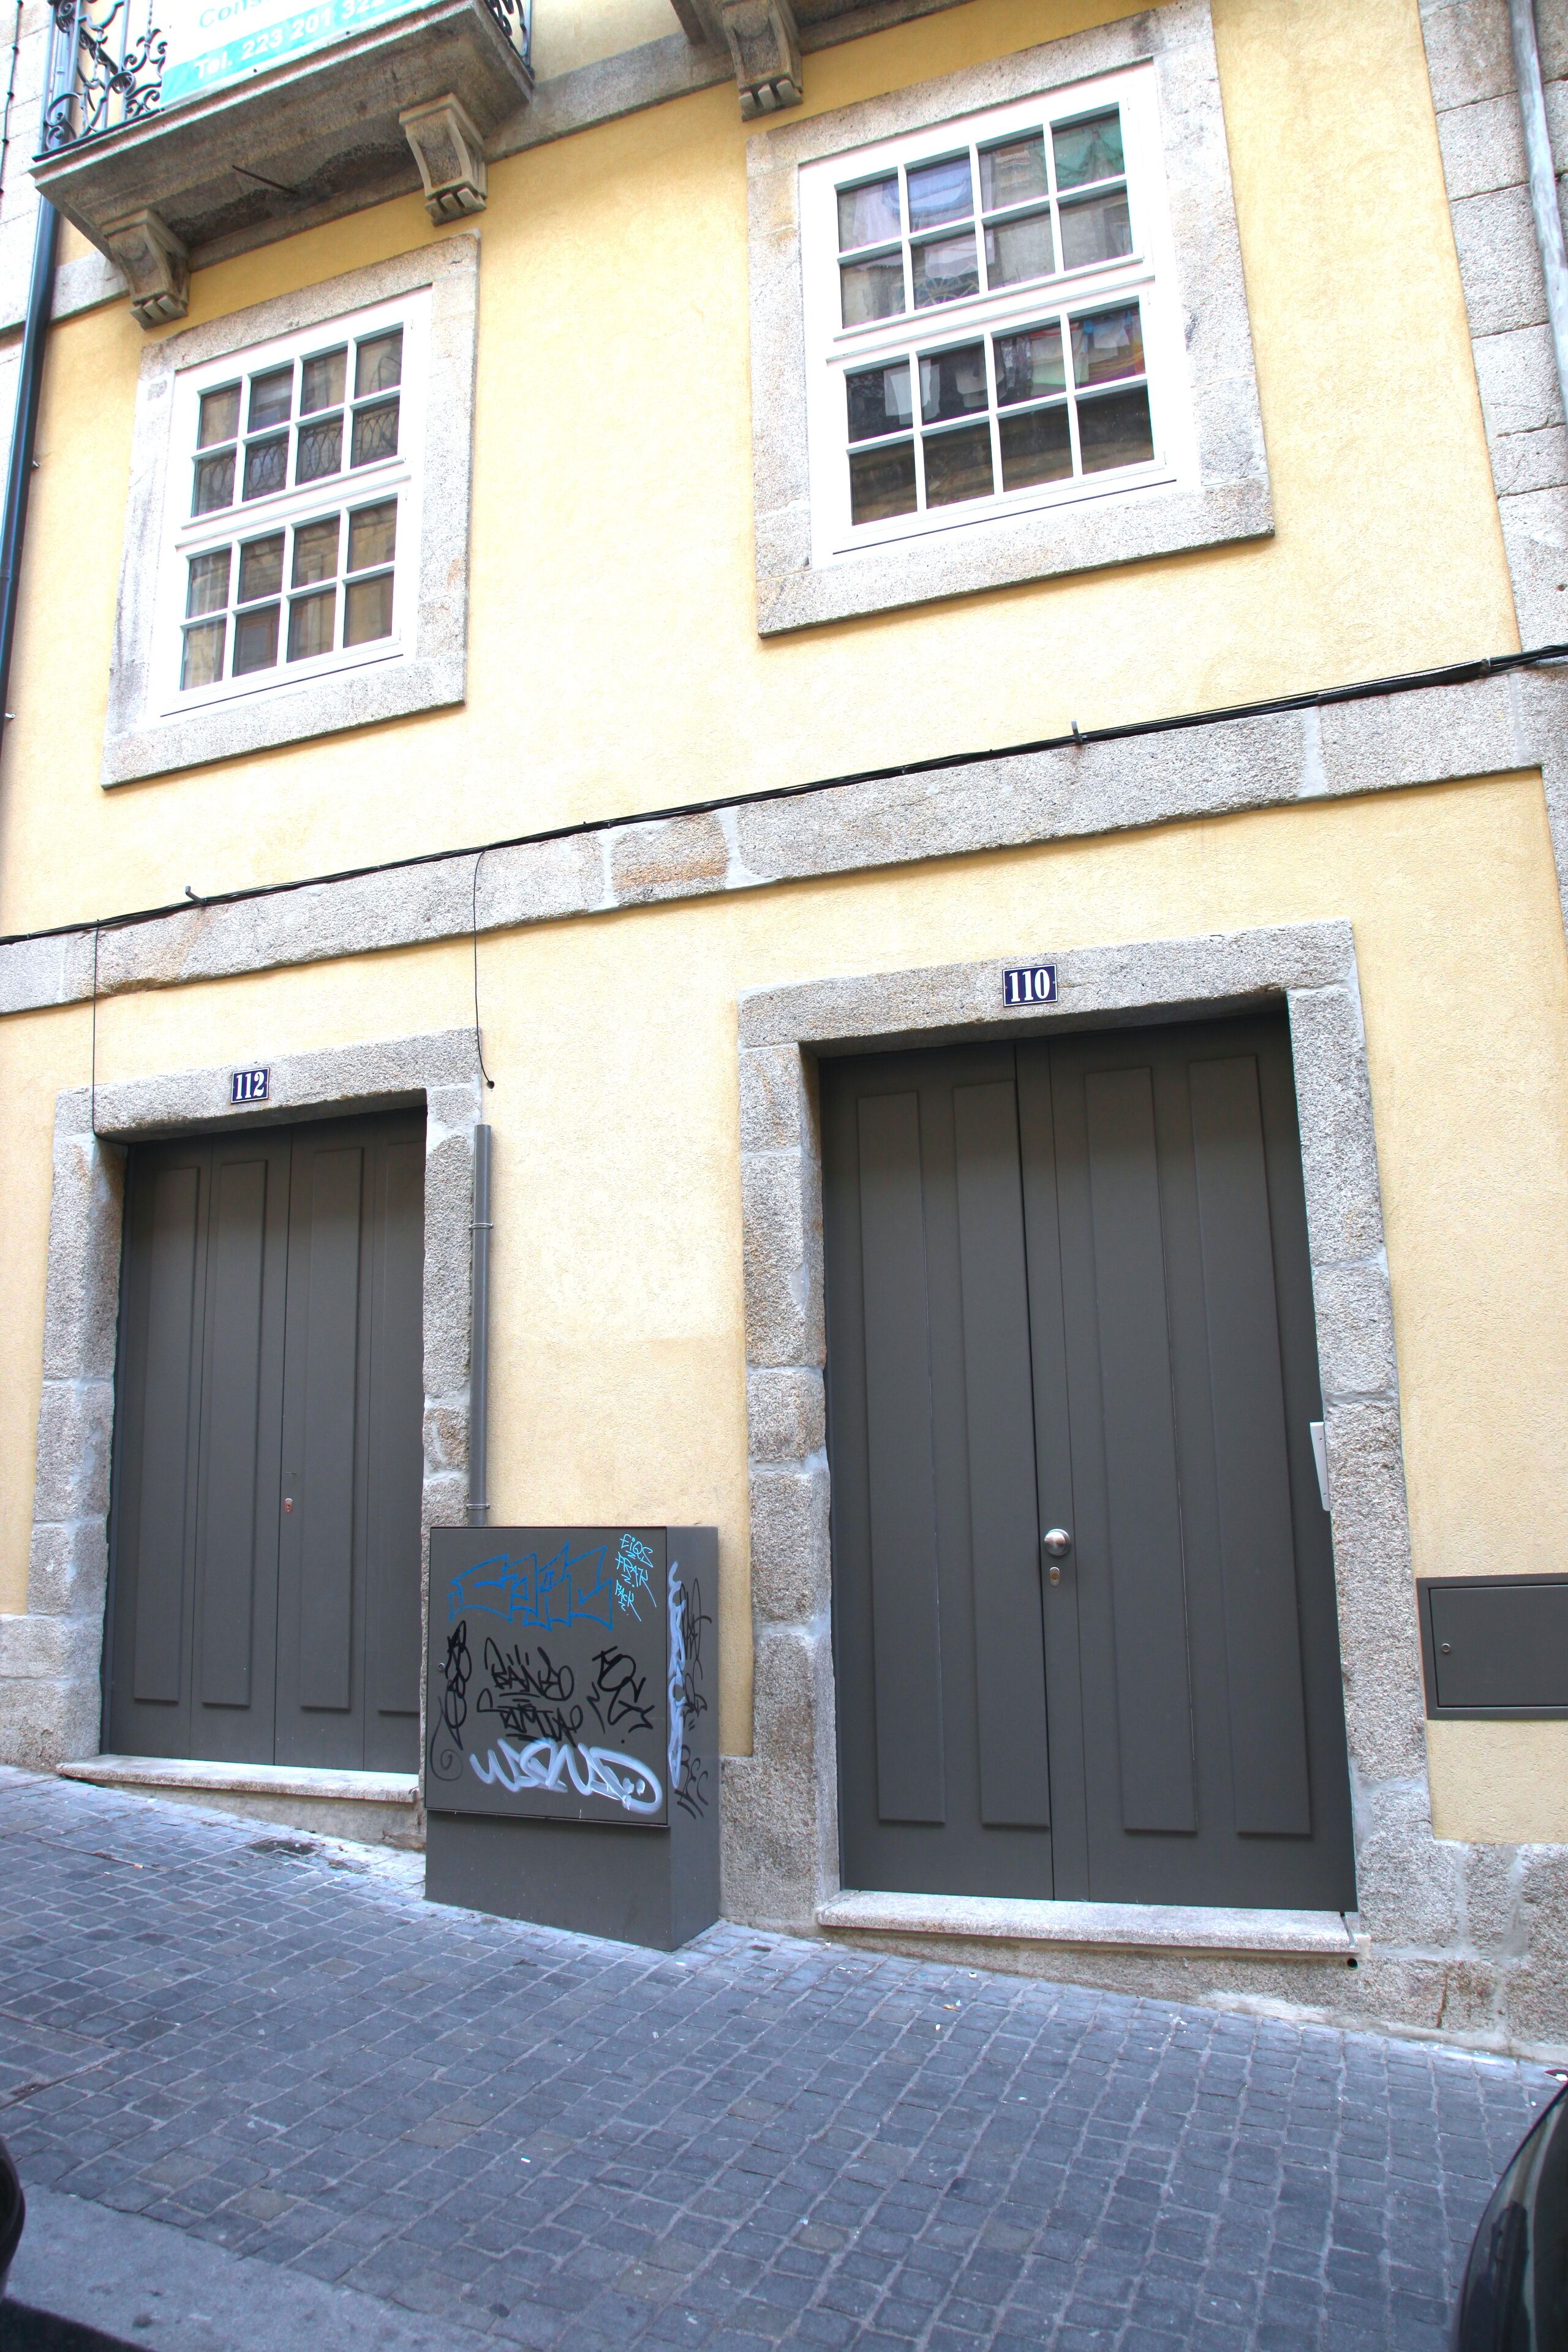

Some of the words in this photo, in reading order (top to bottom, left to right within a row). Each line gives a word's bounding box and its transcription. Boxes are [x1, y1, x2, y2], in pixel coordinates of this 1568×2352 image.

[194, 50, 233, 79] Tel.
[241, 28, 283, 60] 223
[290, 7, 331, 40] 201
[1009, 969, 1050, 1002] 110
[236, 1071, 265, 1100] 112
